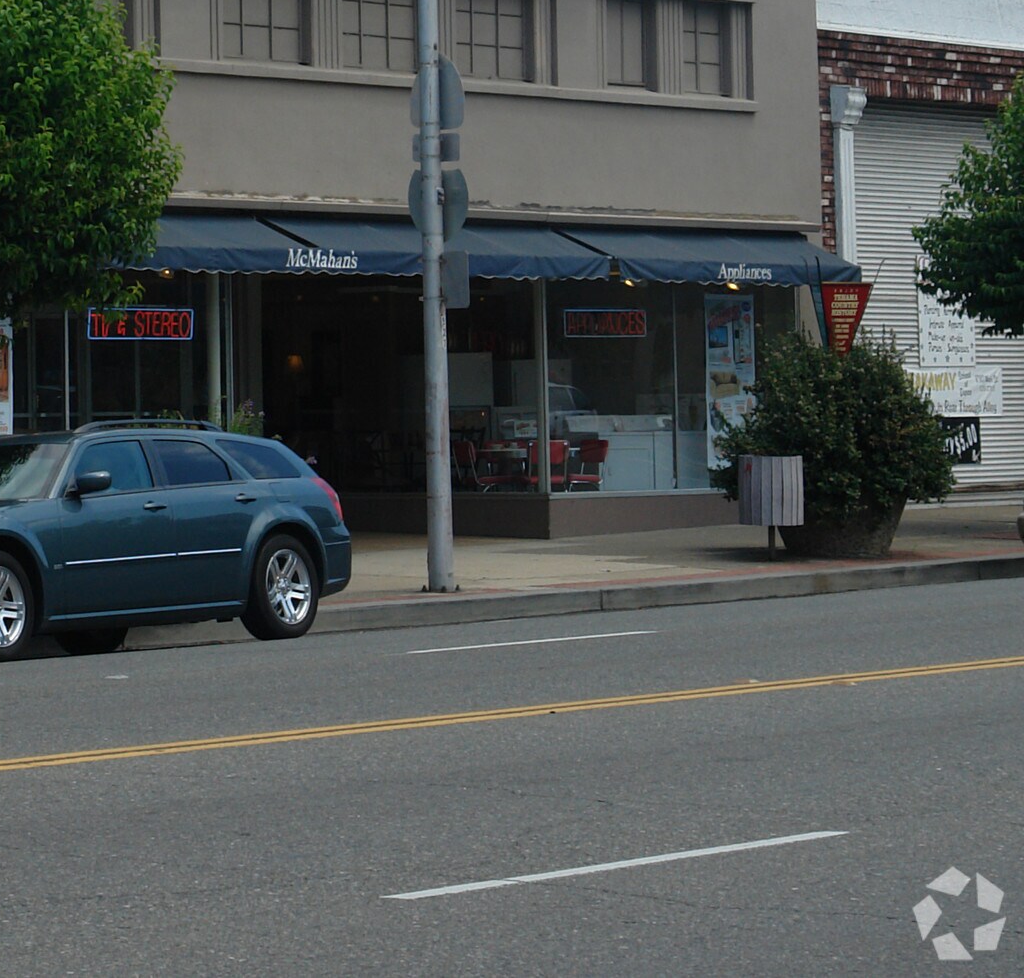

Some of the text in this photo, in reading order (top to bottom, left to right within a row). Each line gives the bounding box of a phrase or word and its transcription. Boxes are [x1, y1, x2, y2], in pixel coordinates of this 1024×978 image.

[285, 248, 359, 269] McMahan's
[717, 263, 773, 282] Appliances
[133, 310, 191, 338] STEREO
